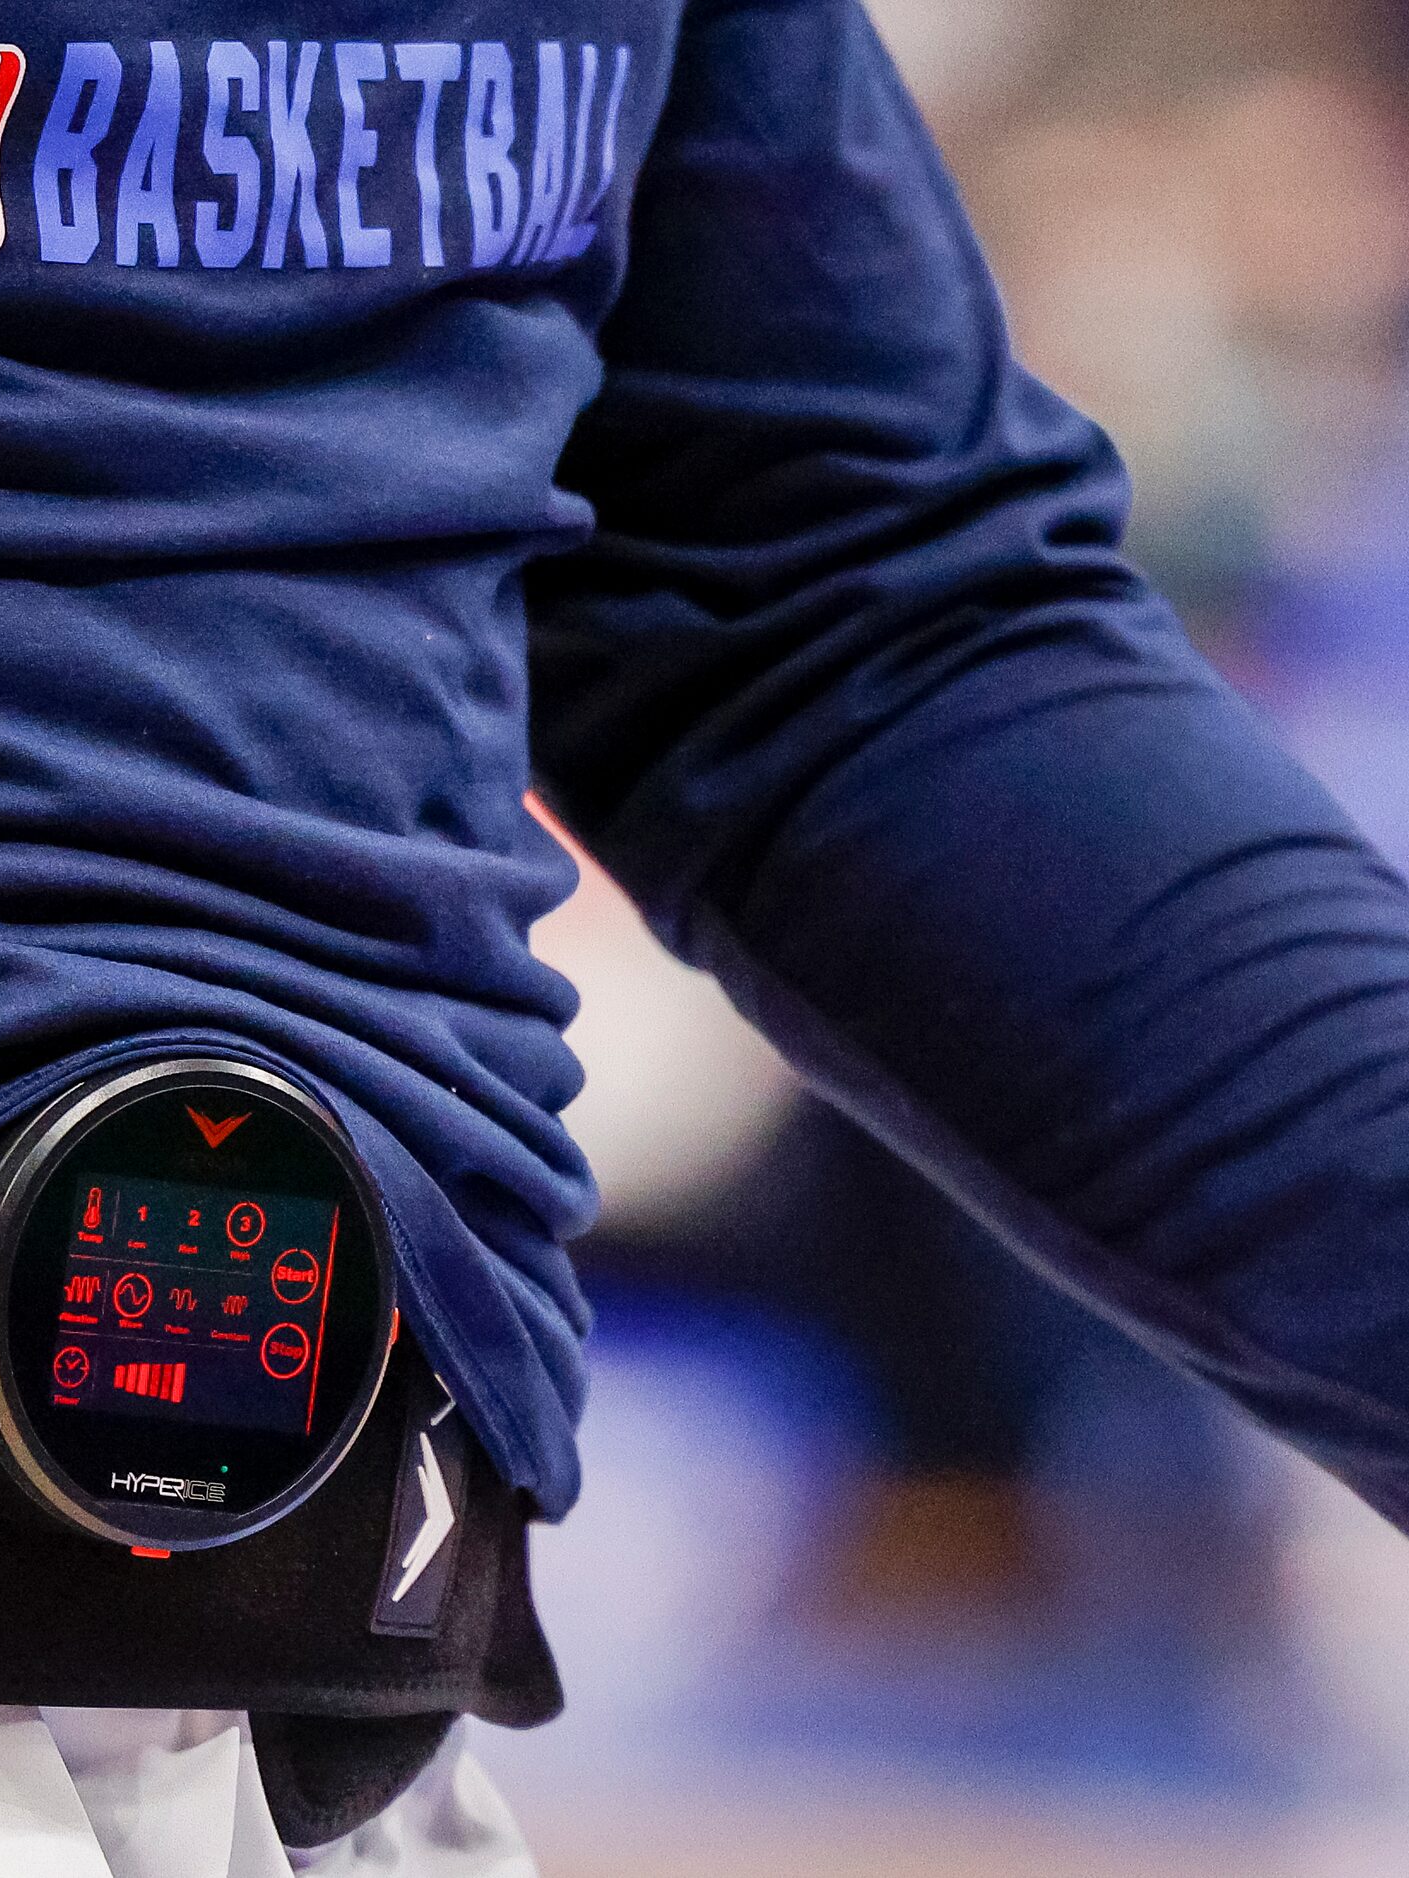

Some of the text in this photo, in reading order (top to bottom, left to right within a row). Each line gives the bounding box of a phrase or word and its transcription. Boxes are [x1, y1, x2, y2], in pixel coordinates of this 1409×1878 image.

[33, 41, 631, 268] BASKETBALL
[138, 1206, 147, 1221] 1
[188, 1210, 200, 1226] 2
[240, 1216, 251, 1231] 3
[276, 1266, 314, 1283] Start
[268, 1341, 304, 1359] Stop
[111, 1472, 225, 1504] HYPERICE
